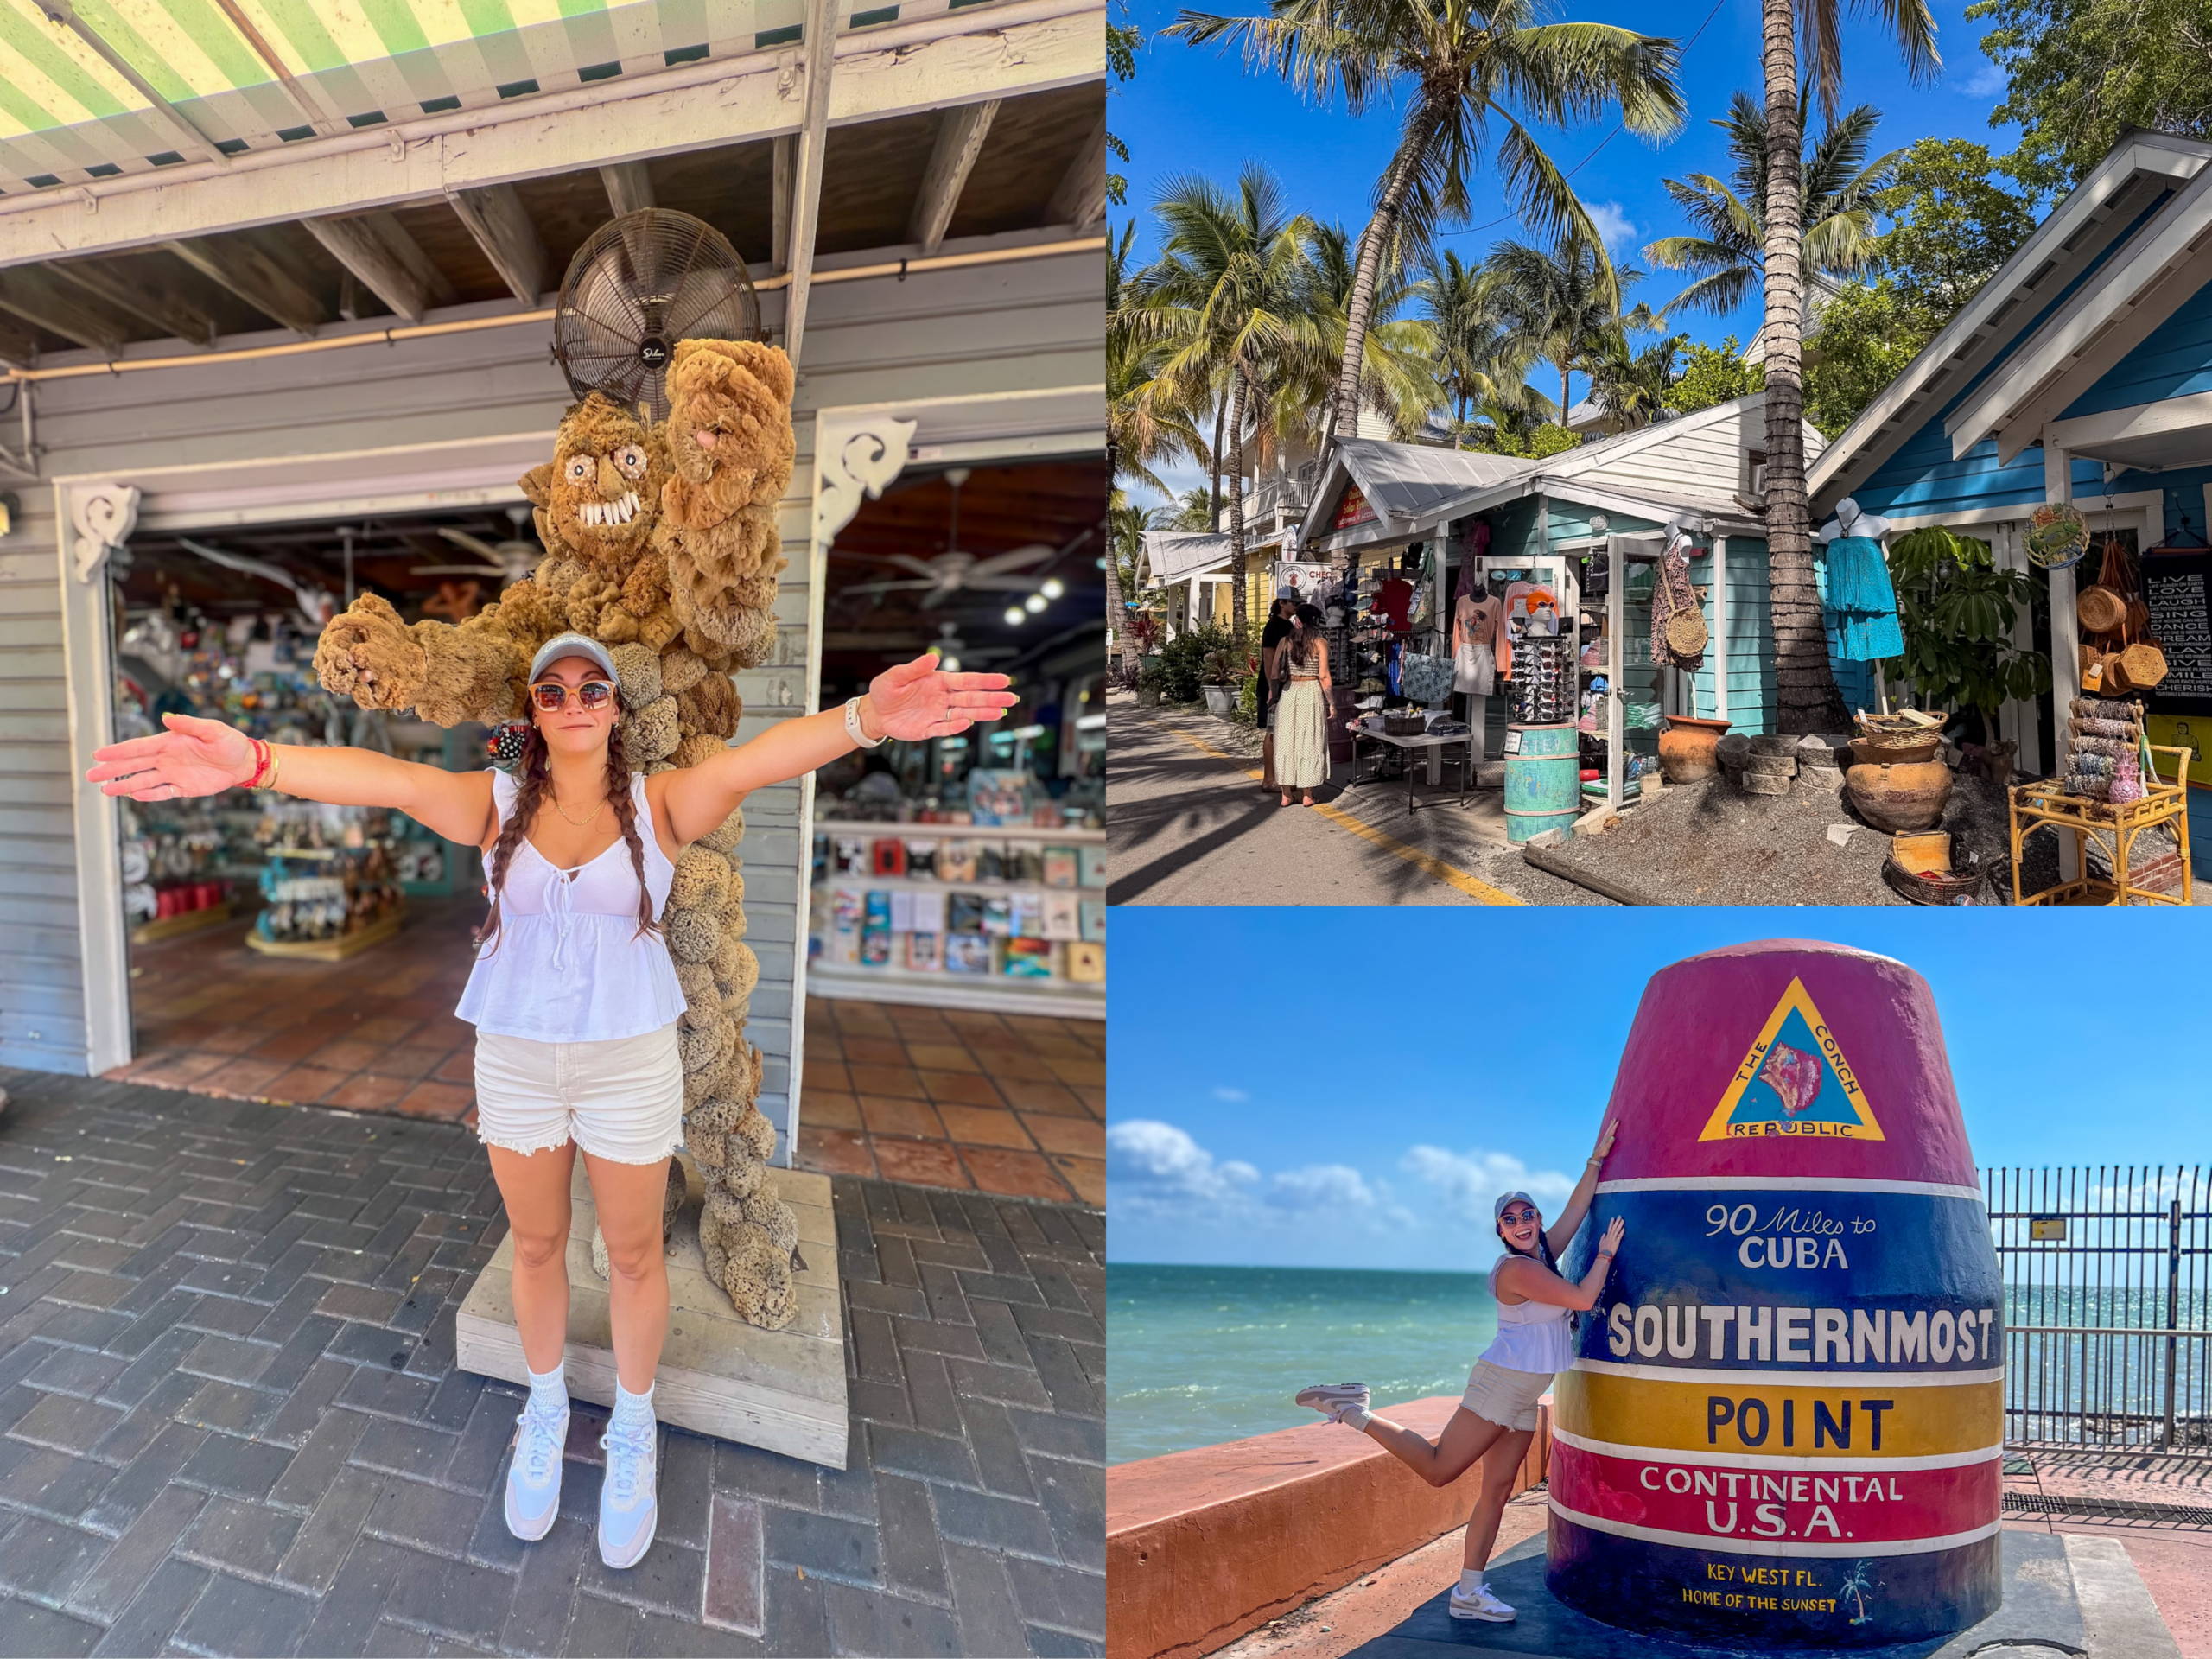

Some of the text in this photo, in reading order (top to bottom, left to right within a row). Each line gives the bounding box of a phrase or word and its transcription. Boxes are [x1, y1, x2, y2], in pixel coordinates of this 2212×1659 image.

[1344, 500, 1370, 514] Solar Prote
[2148, 574, 2203, 584] LIVE
[2149, 586, 2204, 594] LOVE
[2149, 598, 2205, 607] LAUGH
[2150, 610, 2207, 619] SING
[2151, 622, 2209, 631] DANCE
[1736, 1042, 1767, 1082] THE
[1815, 1025, 1859, 1095] CONCH
[1734, 1122, 1853, 1136] REPUBLIC
[1706, 1204, 1876, 1236] 90 Miles to
[1738, 1236, 1849, 1269] CUBA
[1608, 1302, 1993, 1363] SOUTHERNMOST
[1707, 1396, 1895, 1451] POINT
[1640, 1466, 1904, 1503] CONTINENTAL
[1706, 1500, 1853, 1538] U.S.A.
[1707, 1563, 1822, 1587] KEY WEST FL.
[1682, 1588, 1836, 1613] HOME OF THE SUNSET
